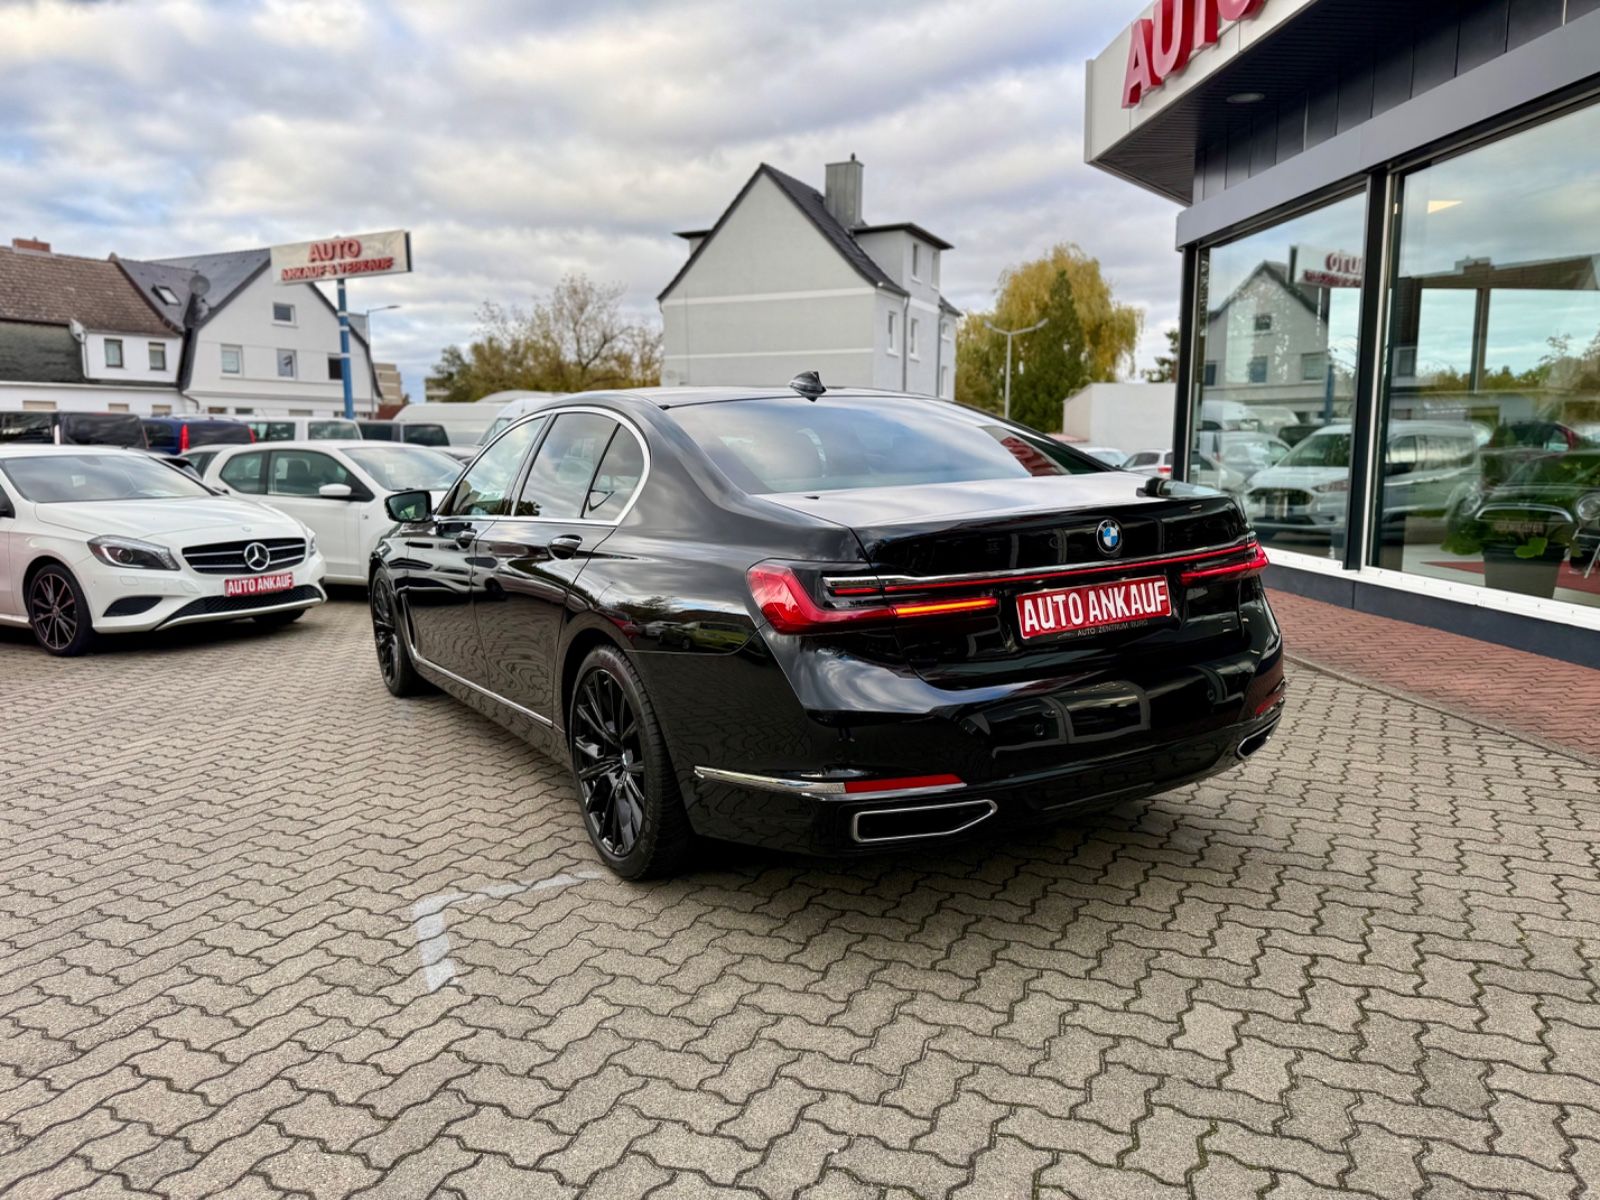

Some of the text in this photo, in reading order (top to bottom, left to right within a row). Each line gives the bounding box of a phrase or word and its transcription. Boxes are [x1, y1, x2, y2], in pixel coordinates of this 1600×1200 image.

[308, 239, 362, 262] AUTO
[228, 575, 292, 593] AUTO ANKAUF
[1024, 581, 1166, 632] AUTO ANKAUF
[1099, 623, 1128, 633] ZENTRUM
